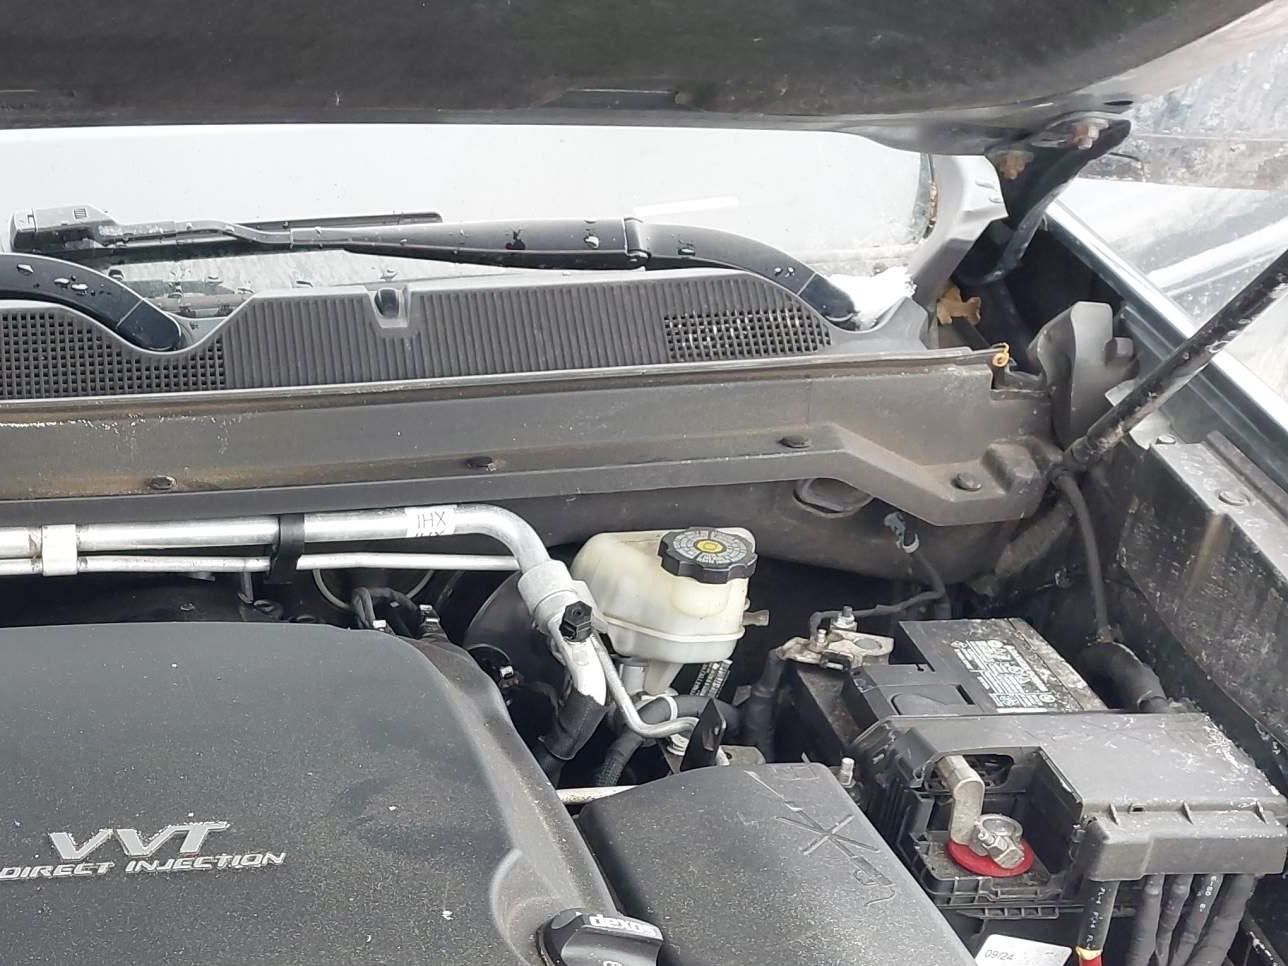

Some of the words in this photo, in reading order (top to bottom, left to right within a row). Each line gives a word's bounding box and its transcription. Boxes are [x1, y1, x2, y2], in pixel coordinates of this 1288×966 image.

[417, 511, 446, 529] IHX
[48, 821, 231, 861] VVT
[124, 851, 287, 874] INJECTION
